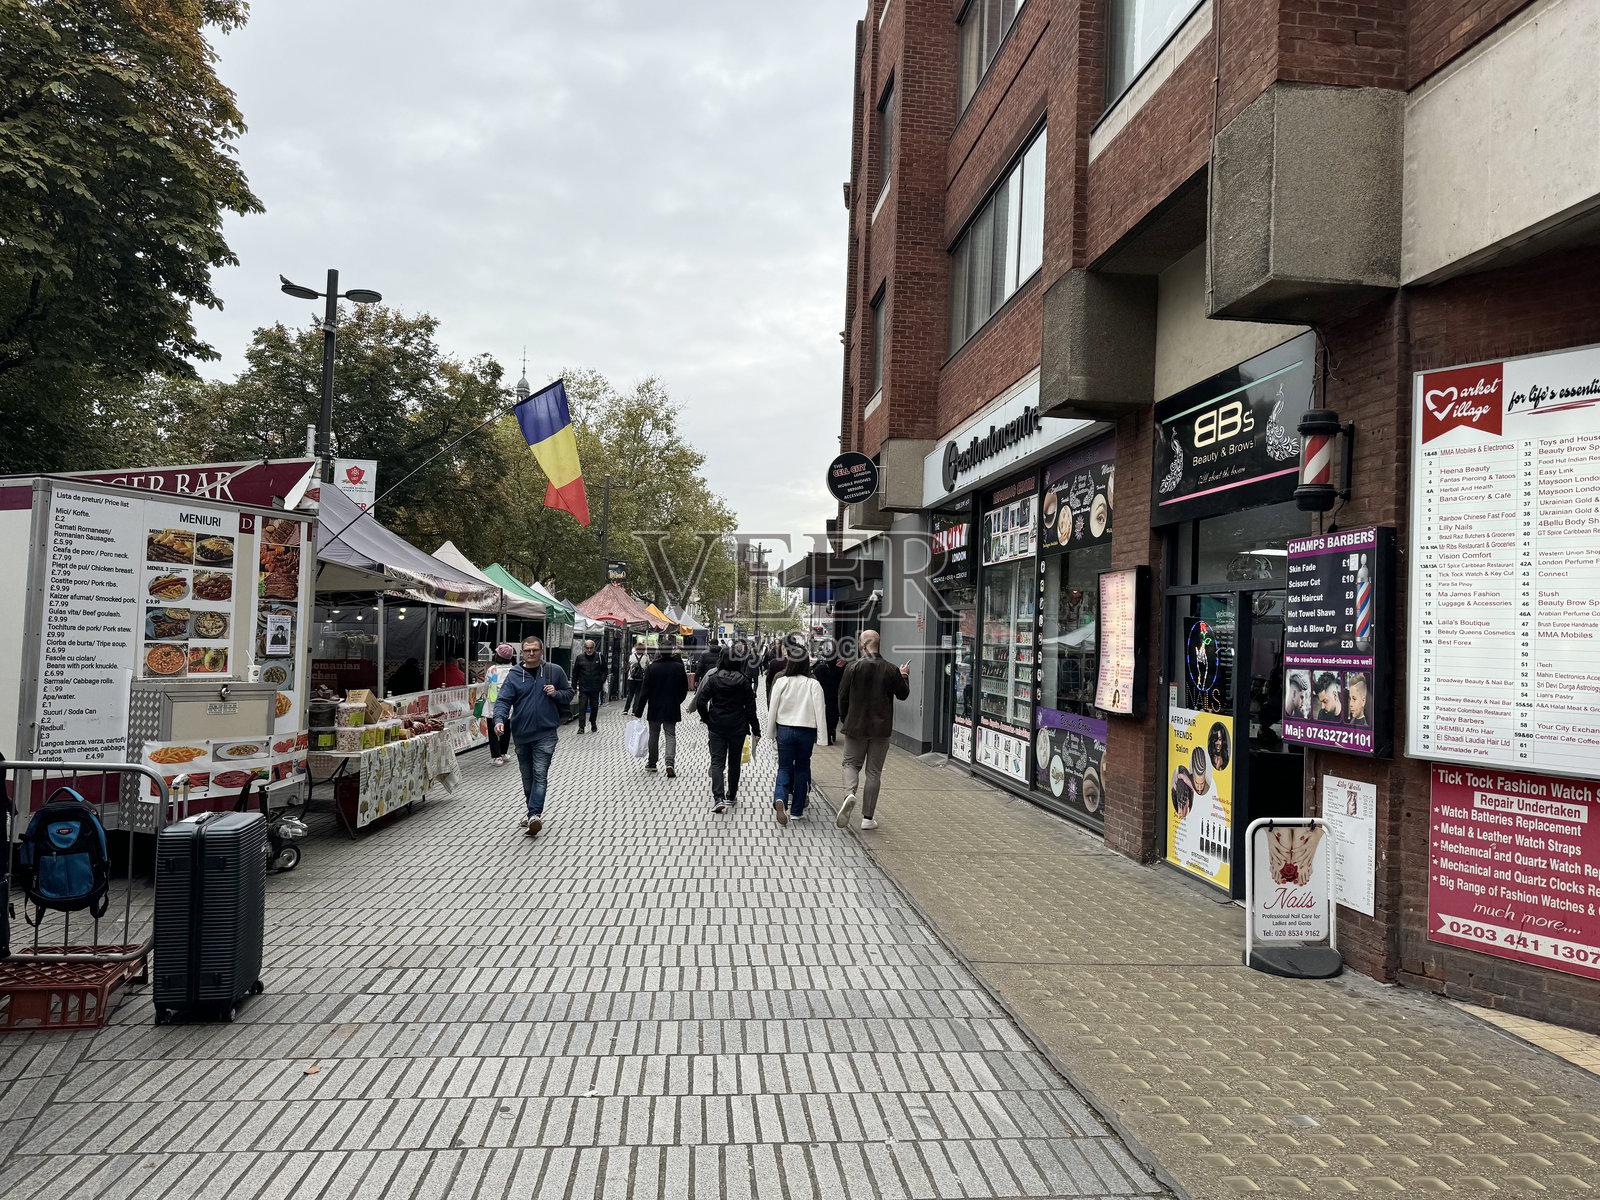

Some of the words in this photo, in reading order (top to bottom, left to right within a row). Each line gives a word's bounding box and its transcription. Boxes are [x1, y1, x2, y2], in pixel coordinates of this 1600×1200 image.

[1425, 378, 1503, 406] Market
[1508, 391, 1527, 412] for
[1432, 400, 1491, 423] Village
[1192, 452, 1218, 466] Beauty
[1220, 447, 1226, 457] &
[1229, 442, 1254, 454] Brows
[833, 468, 850, 477] CELL
[850, 463, 866, 473] CITY
[174, 471, 234, 501] BAR
[180, 512, 221, 527] MENIURI
[1289, 538, 1324, 554] CHAMPS
[1327, 530, 1374, 546] BARBERS
[1289, 565, 1300, 573] Skin
[1302, 563, 1316, 572] Fade
[1289, 579, 1308, 588] Scissor
[1342, 575, 1354, 583] £10
[1288, 595, 1300, 603] Kids
[1302, 594, 1323, 602] Haircut
[1345, 591, 1354, 600] £8
[1317, 609, 1335, 617] Shave
[1345, 608, 1353, 616] £8
[1324, 625, 1337, 634] Dry
[1345, 624, 1353, 632] £7
[1341, 640, 1353, 648] £20
[1171, 715, 1184, 725] AFRO
[1184, 718, 1196, 728] HAIR
[1174, 730, 1192, 741] TRENDS
[1285, 724, 1304, 738] Maj:
[1306, 726, 1371, 747] 07432721101
[1176, 744, 1188, 755] Salon
[1438, 769, 1462, 785] Tick
[1466, 772, 1493, 789] Tock
[1497, 776, 1546, 796] Fashion
[1551, 783, 1592, 802] Watch
[1480, 794, 1514, 809] Repair
[1518, 799, 1581, 819] Undertaken
[1441, 805, 1468, 819] Watch
[1471, 809, 1513, 826] Batteries
[1516, 815, 1581, 836] Replacement
[1441, 822, 1465, 836] Metal
[1468, 827, 1474, 838] &
[1477, 828, 1512, 844] Leather
[1515, 834, 1545, 850] Watch
[1548, 839, 1581, 857] Straps
[1440, 840, 1491, 859] Mechanical
[1494, 851, 1512, 863] and
[1515, 853, 1547, 868] Quartz
[1550, 858, 1581, 874] Watch
[1440, 857, 1491, 877] Mechanical
[1494, 869, 1511, 881] and
[1514, 871, 1547, 888] Quartz
[1550, 877, 1585, 894] Clocks
[1264, 887, 1317, 910] Nails
[1440, 875, 1454, 891] Big
[1457, 878, 1486, 896] Range
[1488, 886, 1498, 896] of
[1500, 887, 1538, 904] Fashion
[1541, 894, 1585, 914] Watches
[1588, 904, 1595, 916] &
[1473, 903, 1516, 921] much
[1450, 921, 1497, 942] 0203
[1503, 934, 1540, 951] 441
[1550, 944, 1600, 965] 1307
